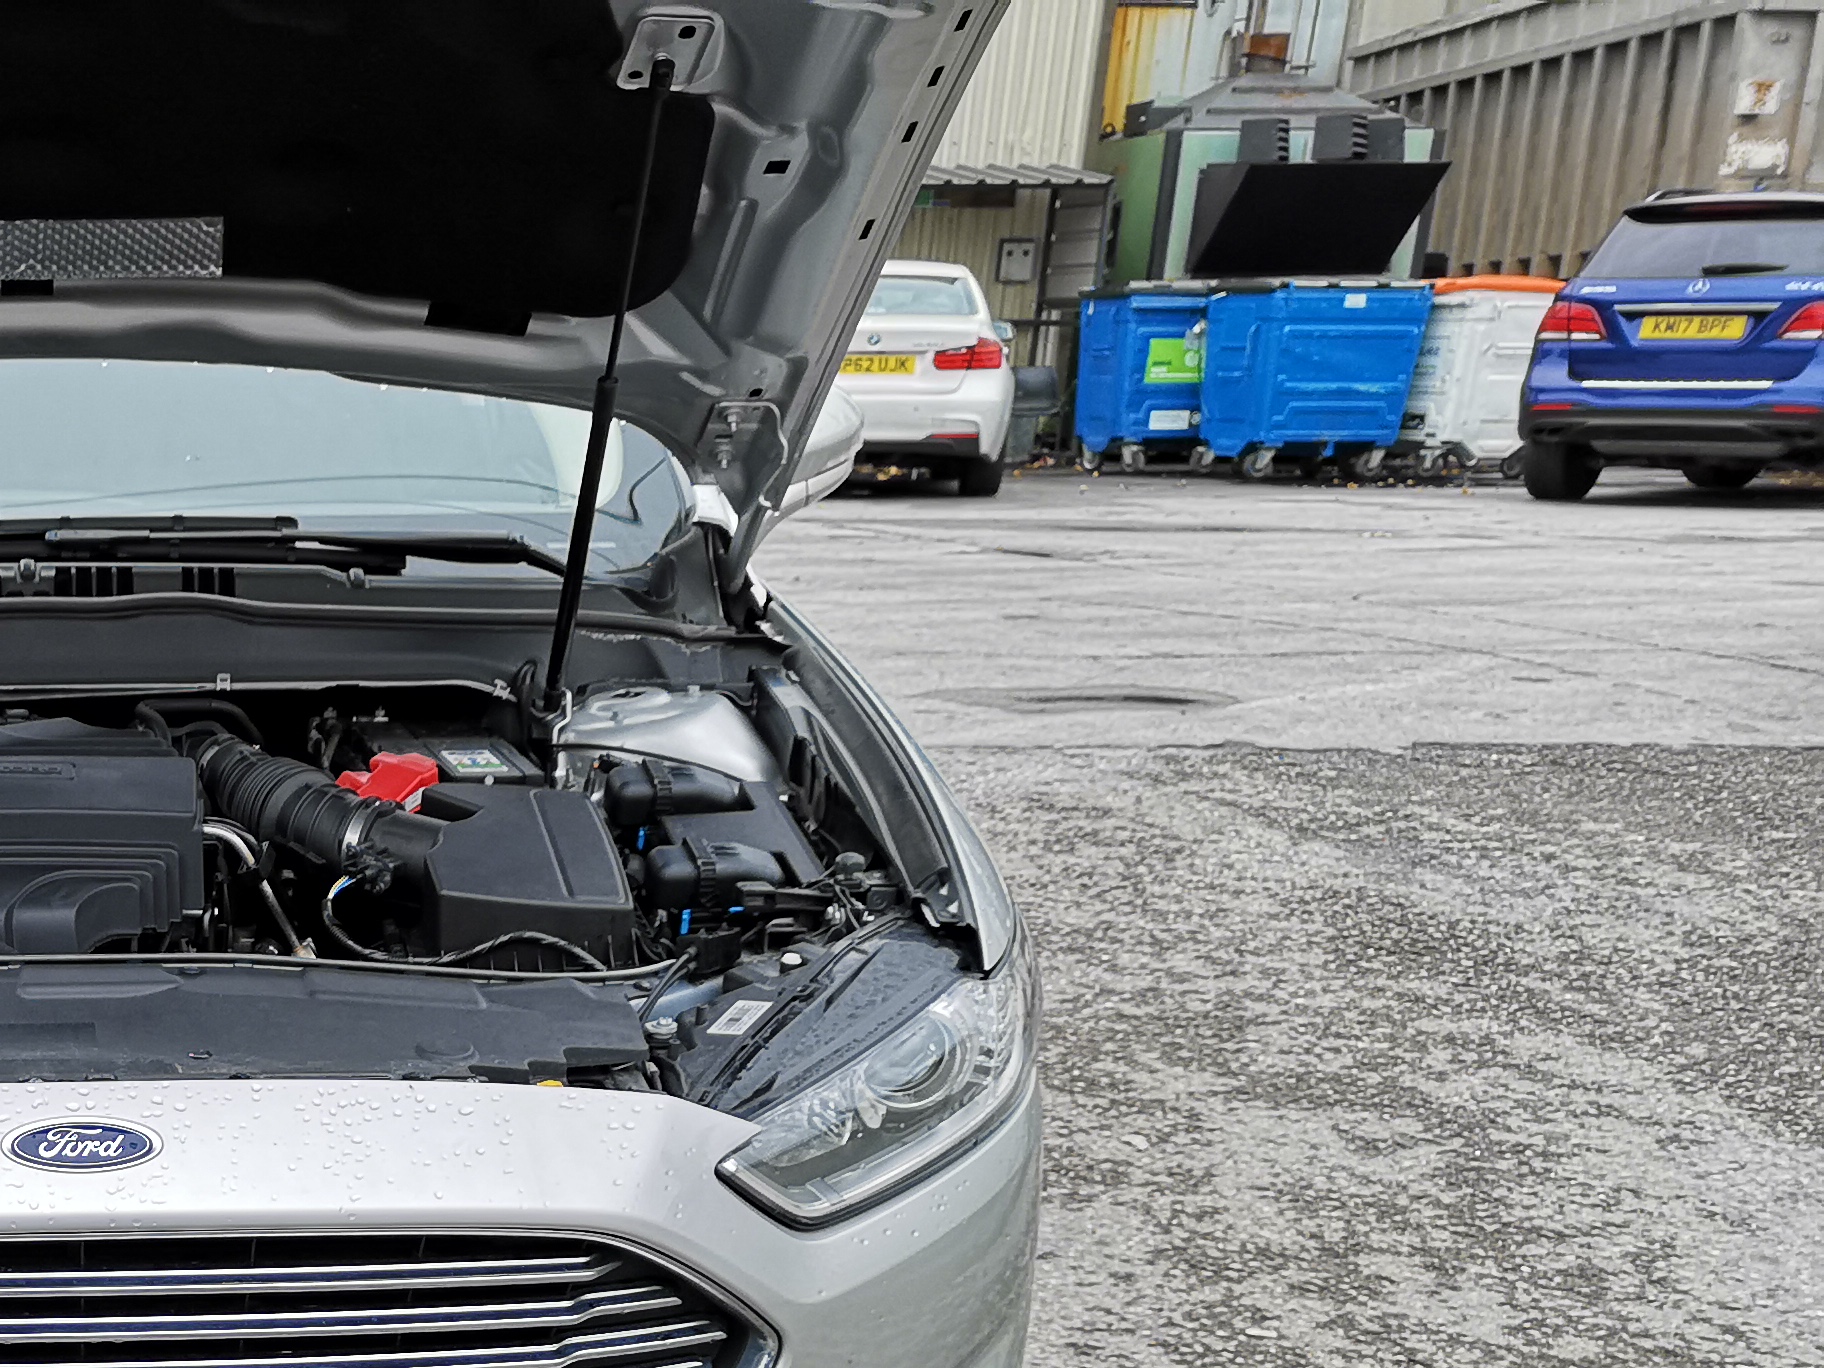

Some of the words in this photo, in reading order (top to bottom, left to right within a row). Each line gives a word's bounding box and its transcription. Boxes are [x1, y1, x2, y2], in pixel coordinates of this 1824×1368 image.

[1697, 316, 1735, 334] BPF
[878, 356, 910, 373] UJK
[38, 1127, 126, 1158] Ford
